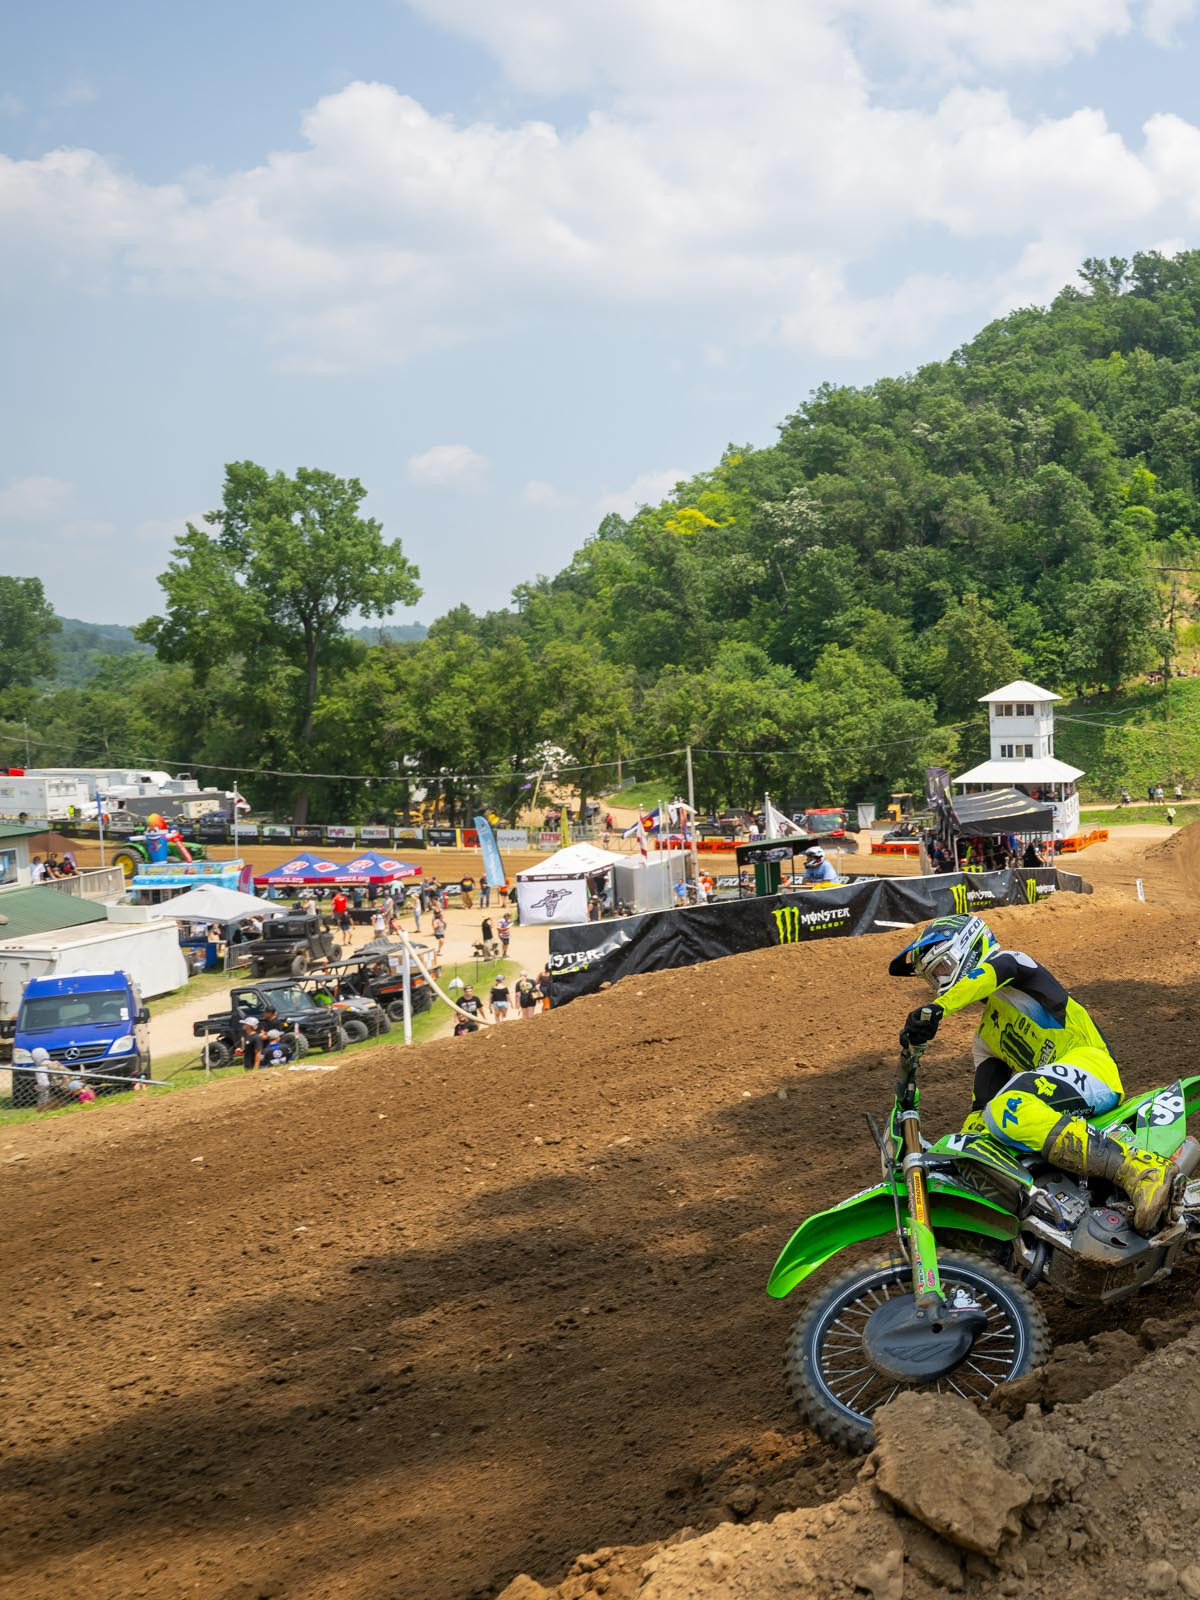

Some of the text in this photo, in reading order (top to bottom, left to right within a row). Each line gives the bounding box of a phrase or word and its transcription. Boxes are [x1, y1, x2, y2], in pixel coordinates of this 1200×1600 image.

[801, 906, 851, 926] MONSTER
[809, 921, 845, 932] ENERGY
[1002, 1097, 1023, 1129] 74
[1137, 1091, 1186, 1126] 36
[914, 1175, 922, 1205] SHOWA
